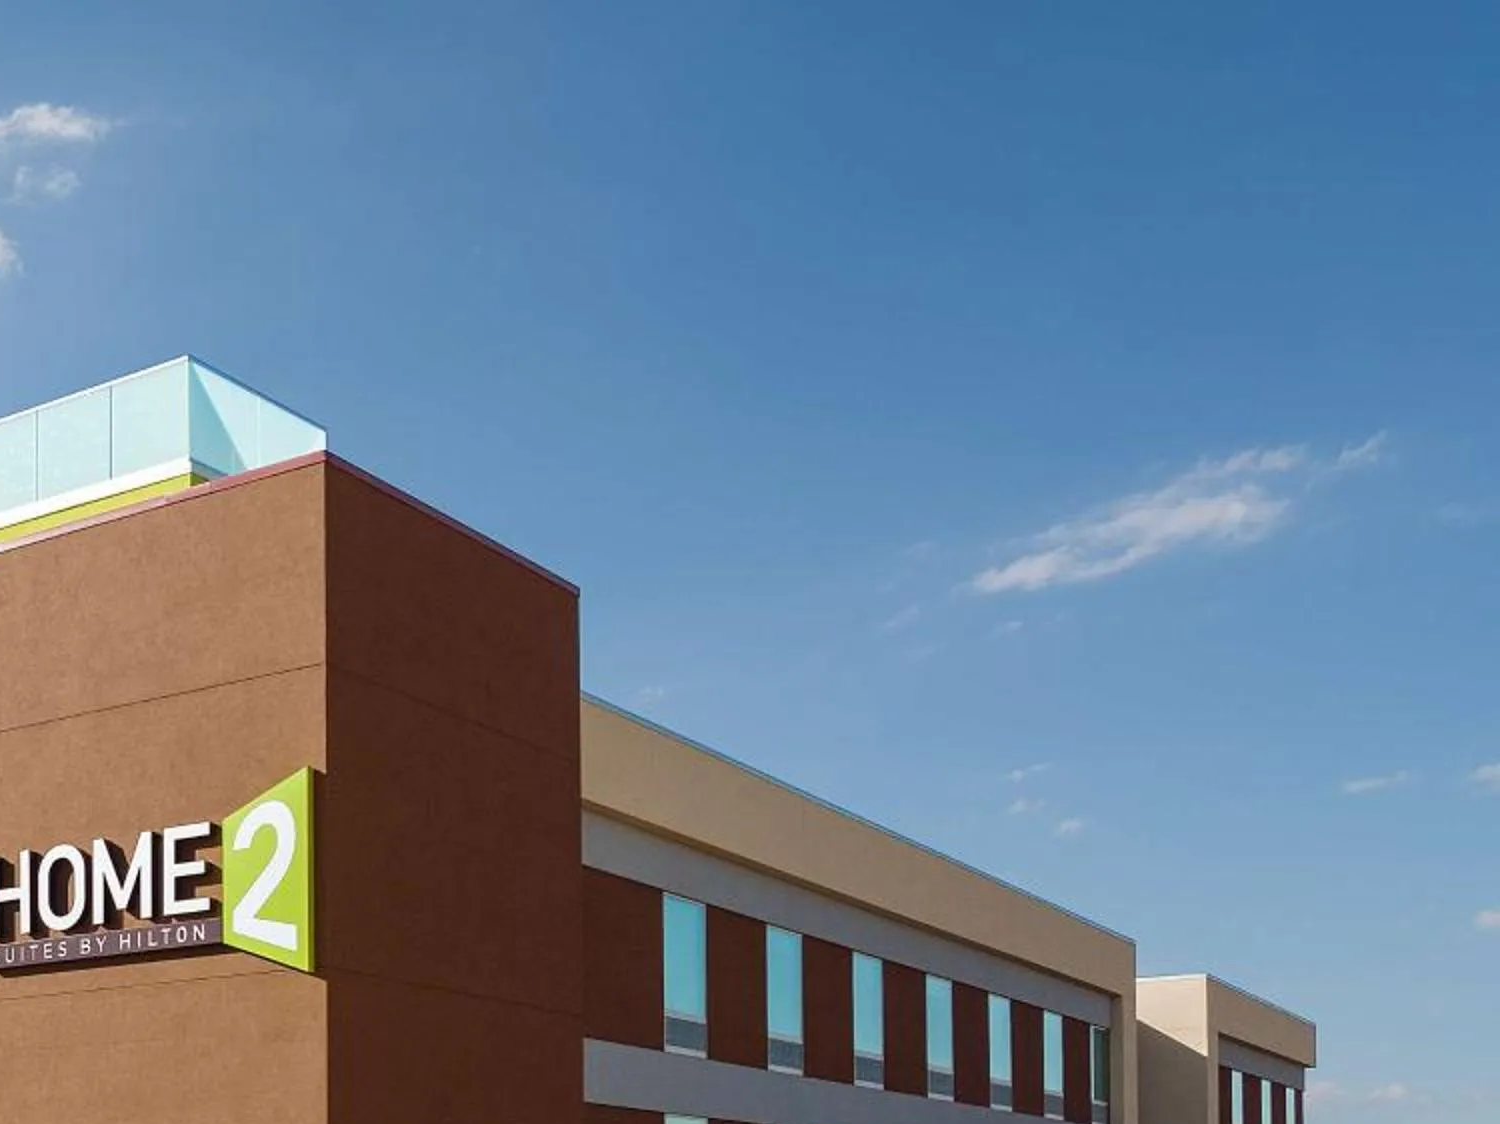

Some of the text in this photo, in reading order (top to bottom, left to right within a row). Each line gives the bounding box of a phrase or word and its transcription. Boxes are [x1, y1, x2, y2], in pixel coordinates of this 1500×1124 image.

[232, 800, 298, 952] 2
[79, 935, 106, 955] BY
[118, 923, 206, 950] HILTON
